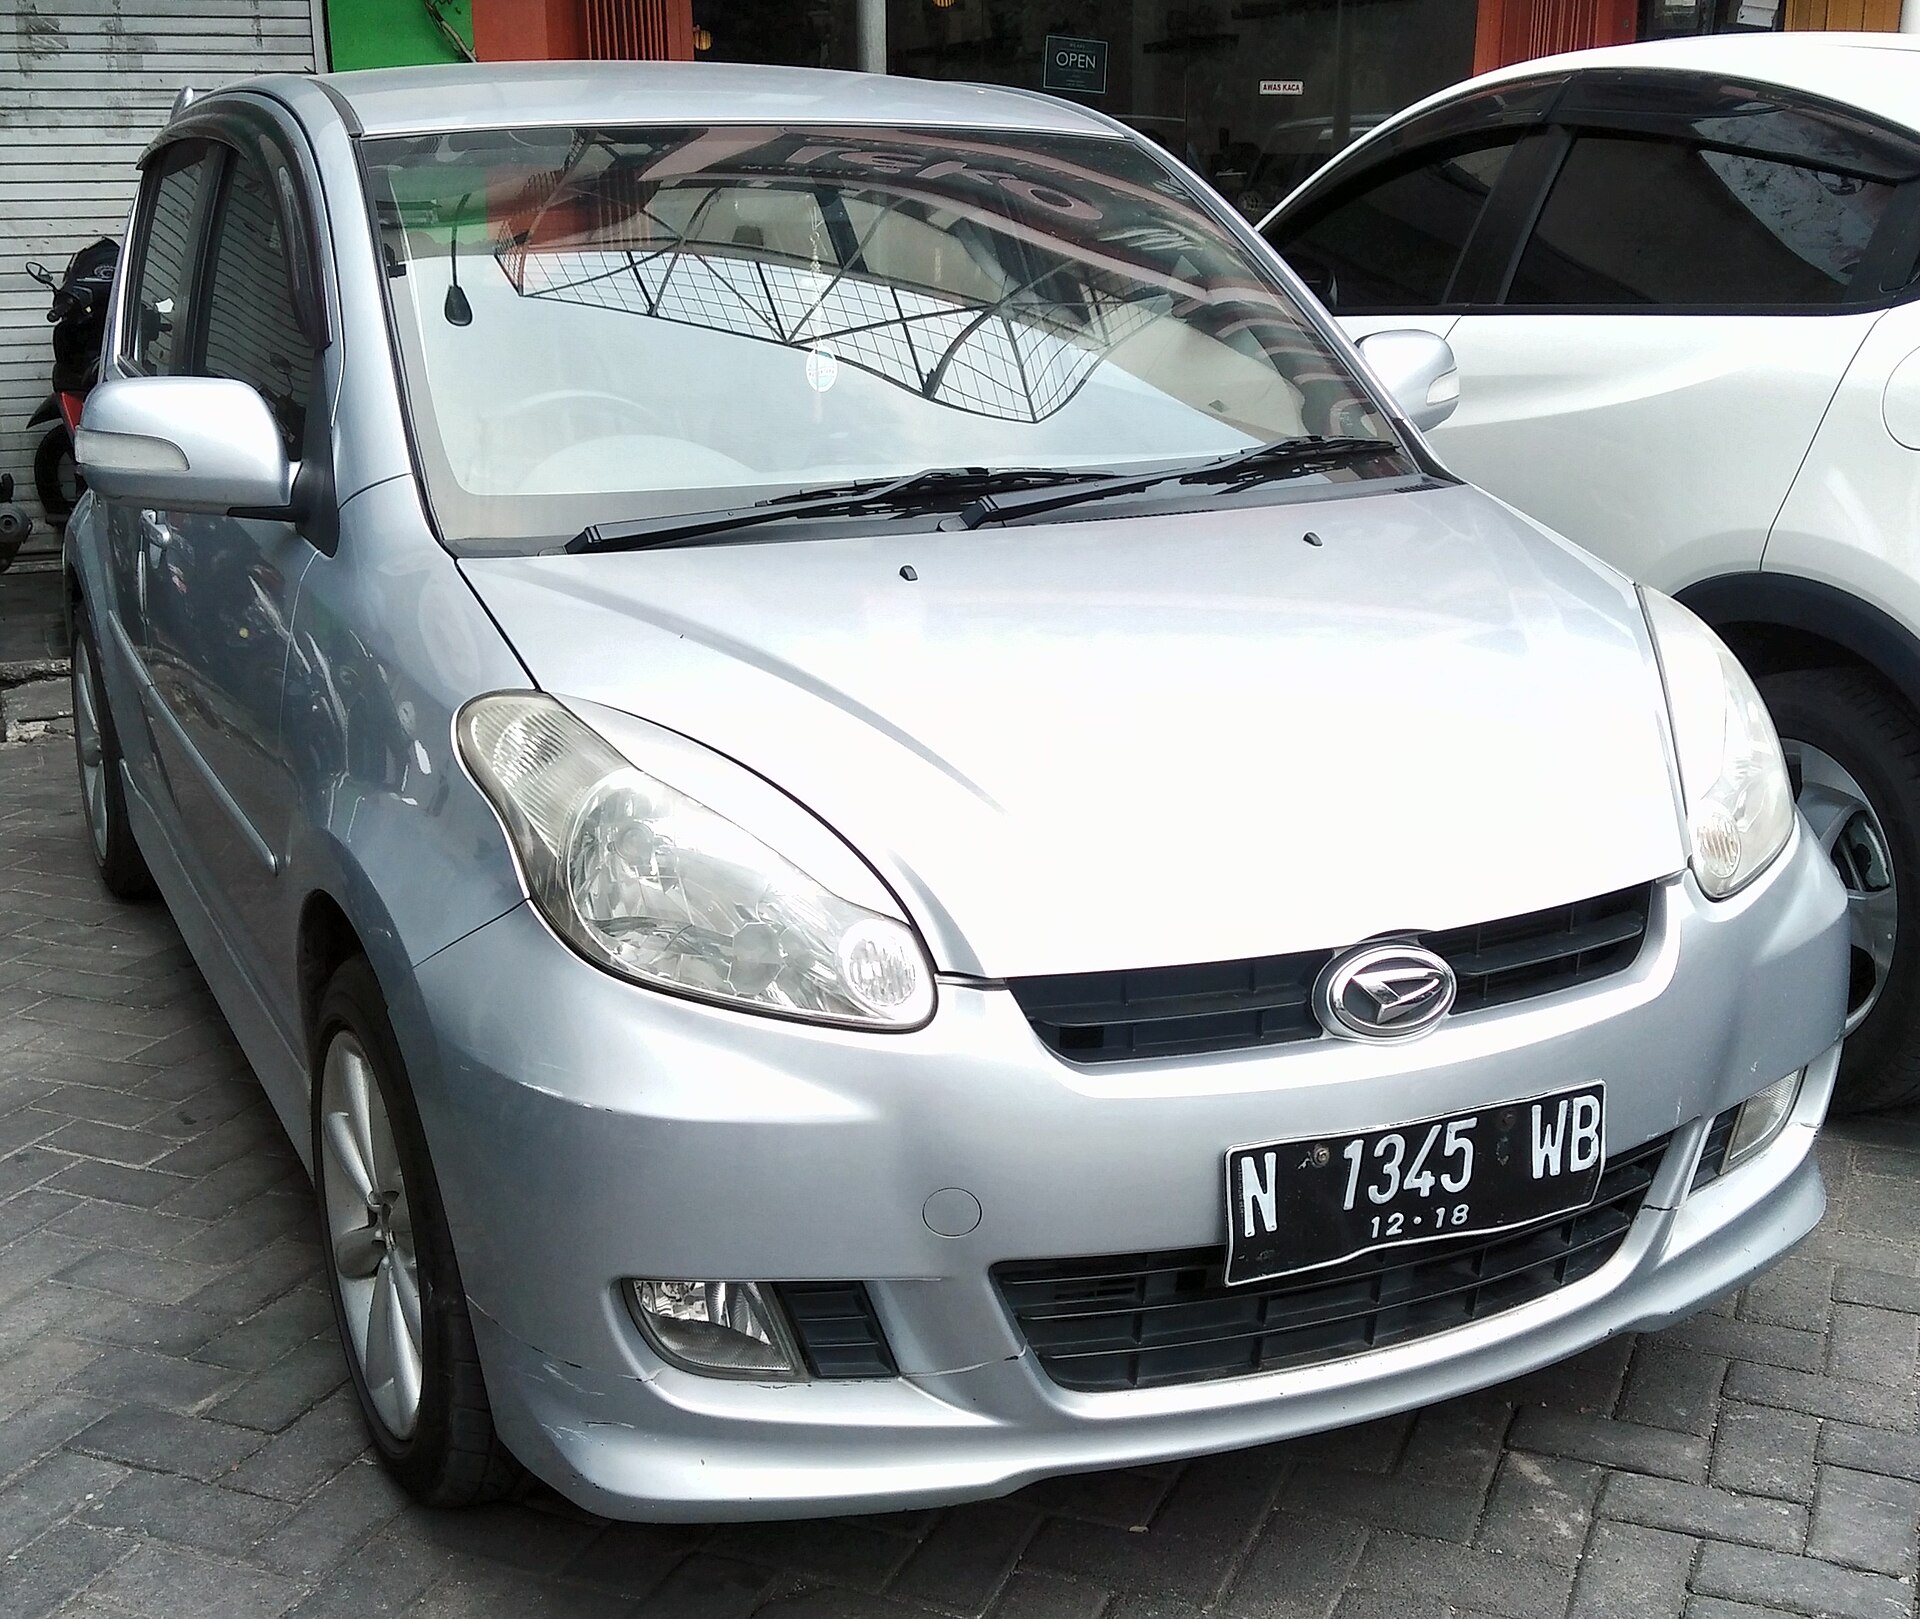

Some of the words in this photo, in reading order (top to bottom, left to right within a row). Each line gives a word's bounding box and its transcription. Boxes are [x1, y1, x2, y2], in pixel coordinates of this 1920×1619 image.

[1055, 51, 1096, 69] OPEN
[1263, 83, 1281, 91] AWAS
[1282, 83, 1300, 92] KACA
[1240, 1152, 1278, 1238] N
[1342, 1117, 1478, 1211] 1345
[1531, 1095, 1600, 1180] WB
